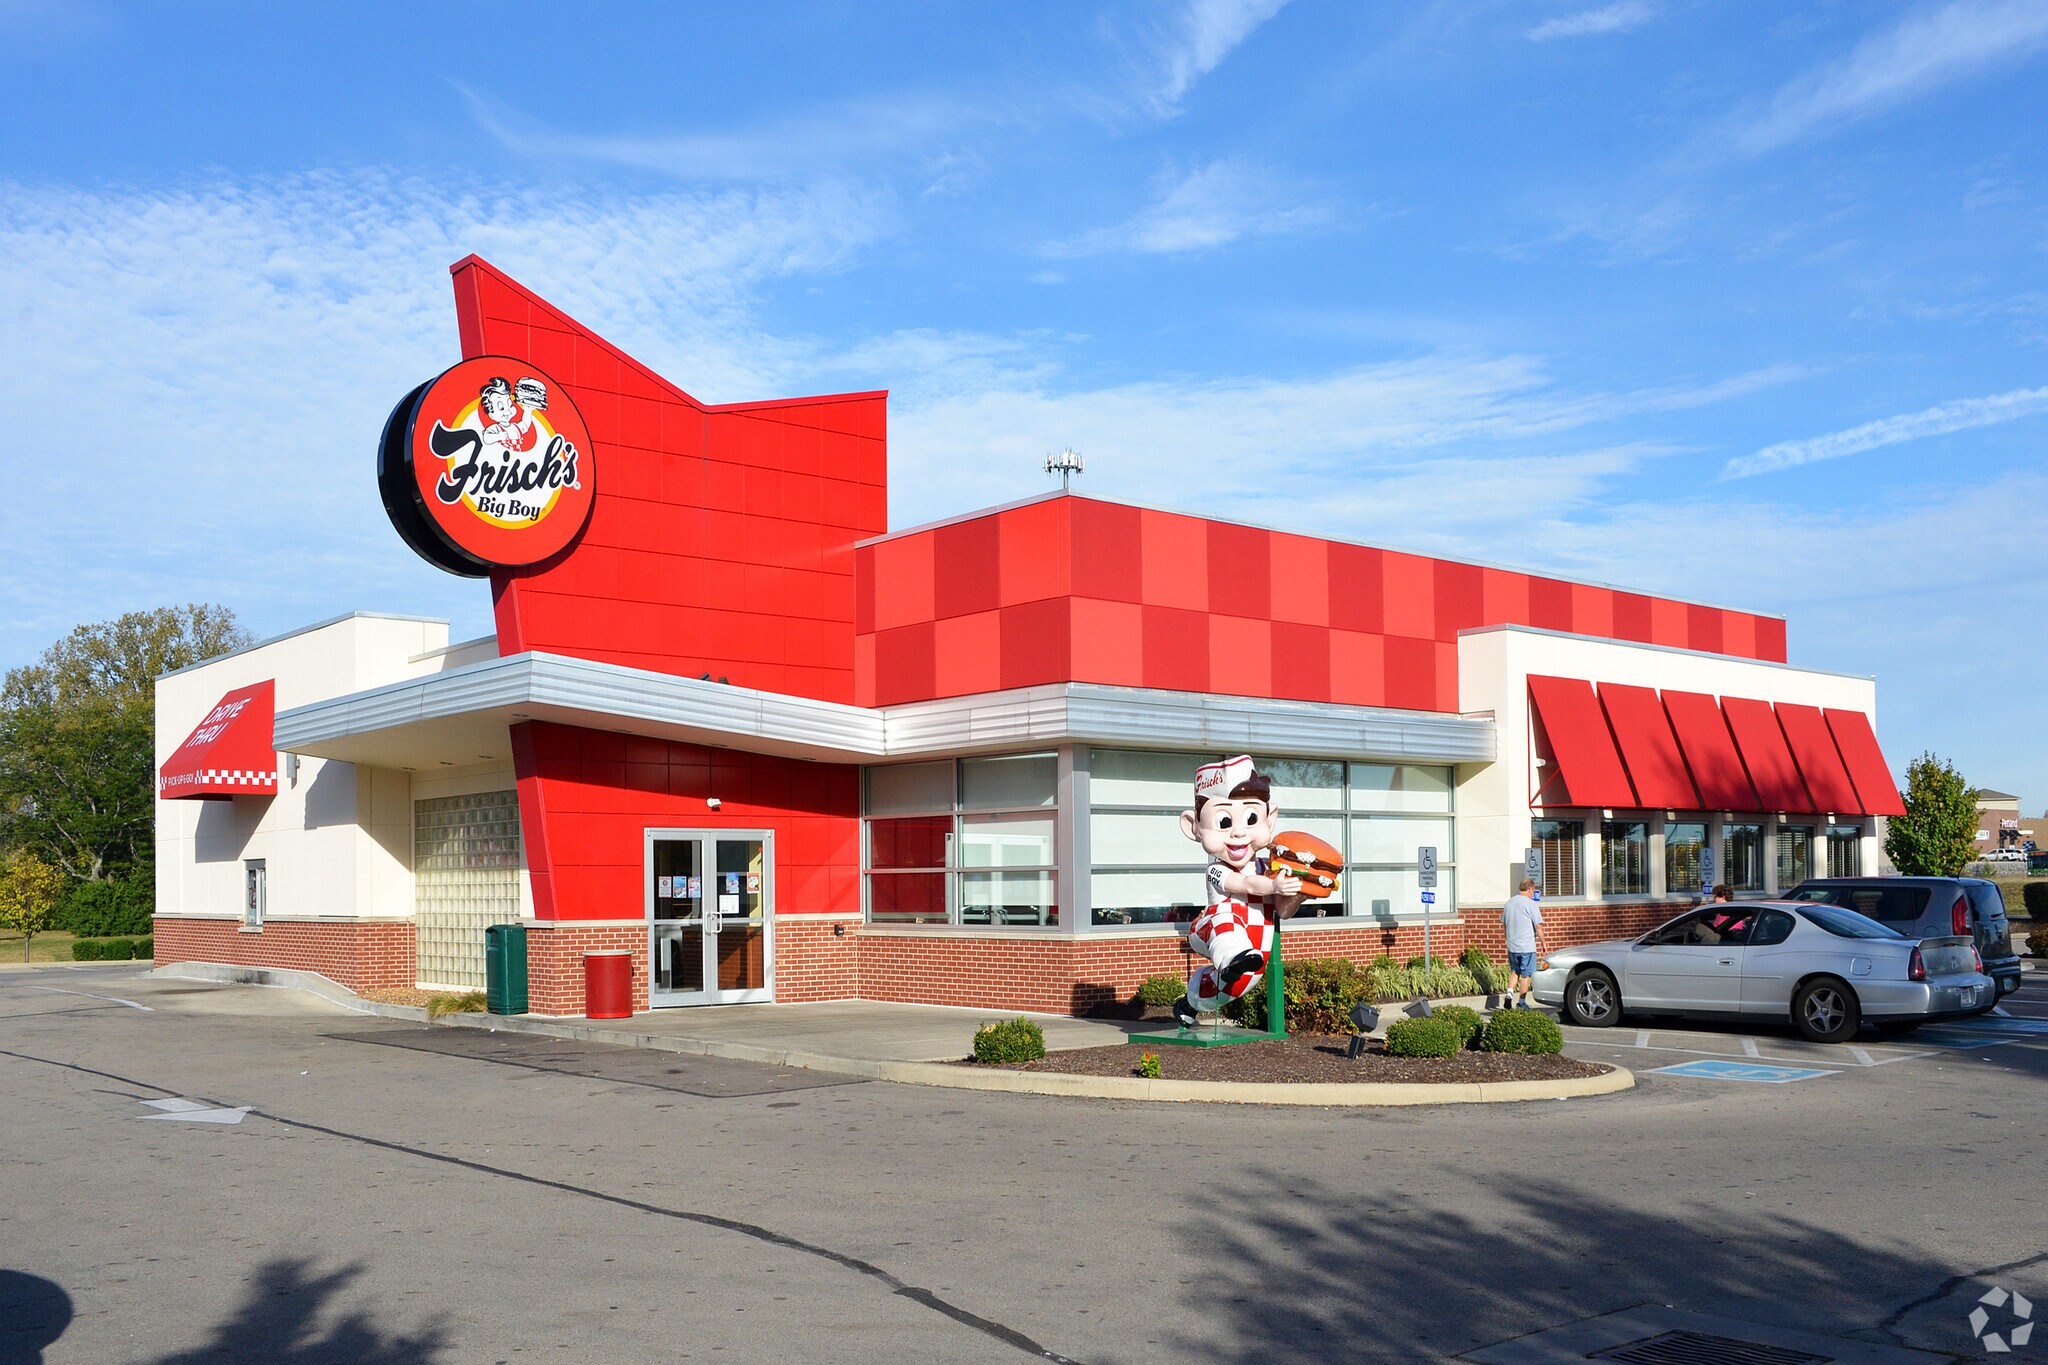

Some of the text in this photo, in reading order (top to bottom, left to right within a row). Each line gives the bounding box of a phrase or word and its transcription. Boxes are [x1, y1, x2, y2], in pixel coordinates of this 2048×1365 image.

[431, 421, 577, 503] Frisch's
[477, 497, 541, 521] Big Boy
[202, 698, 251, 726] DRIVE
[186, 722, 229, 748] THRU
[1195, 769, 1224, 793] Frisch's
[2002, 818, 2018, 828] Petland
[1208, 874, 1221, 887] BOY
[1210, 867, 1222, 879] BIG
